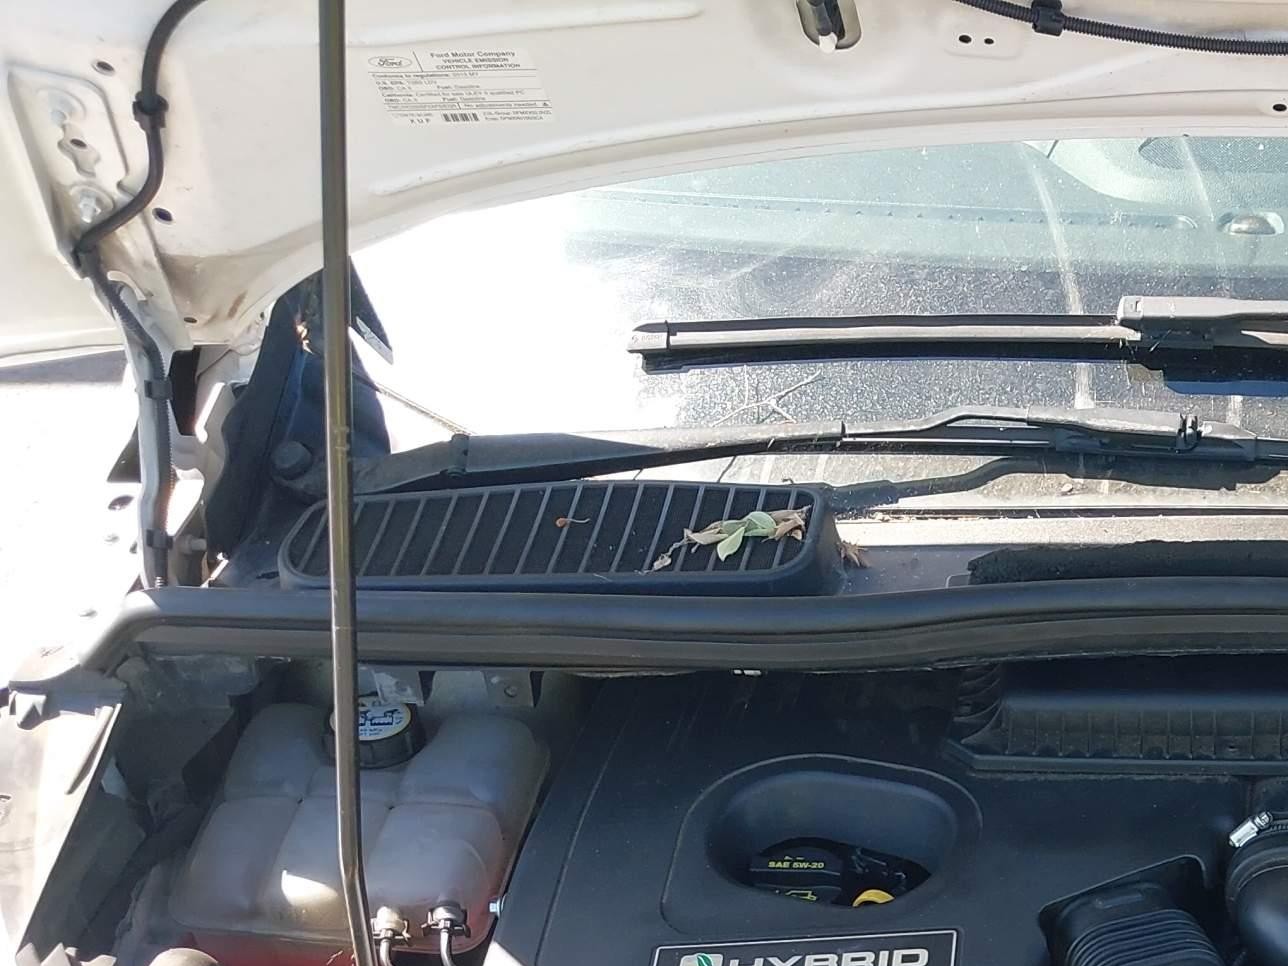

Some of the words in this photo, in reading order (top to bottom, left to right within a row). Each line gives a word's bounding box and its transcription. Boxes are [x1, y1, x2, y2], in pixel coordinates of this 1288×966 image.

[477, 50, 516, 58] Company
[767, 860, 789, 869] SAE
[792, 860, 825, 869] 5W-20
